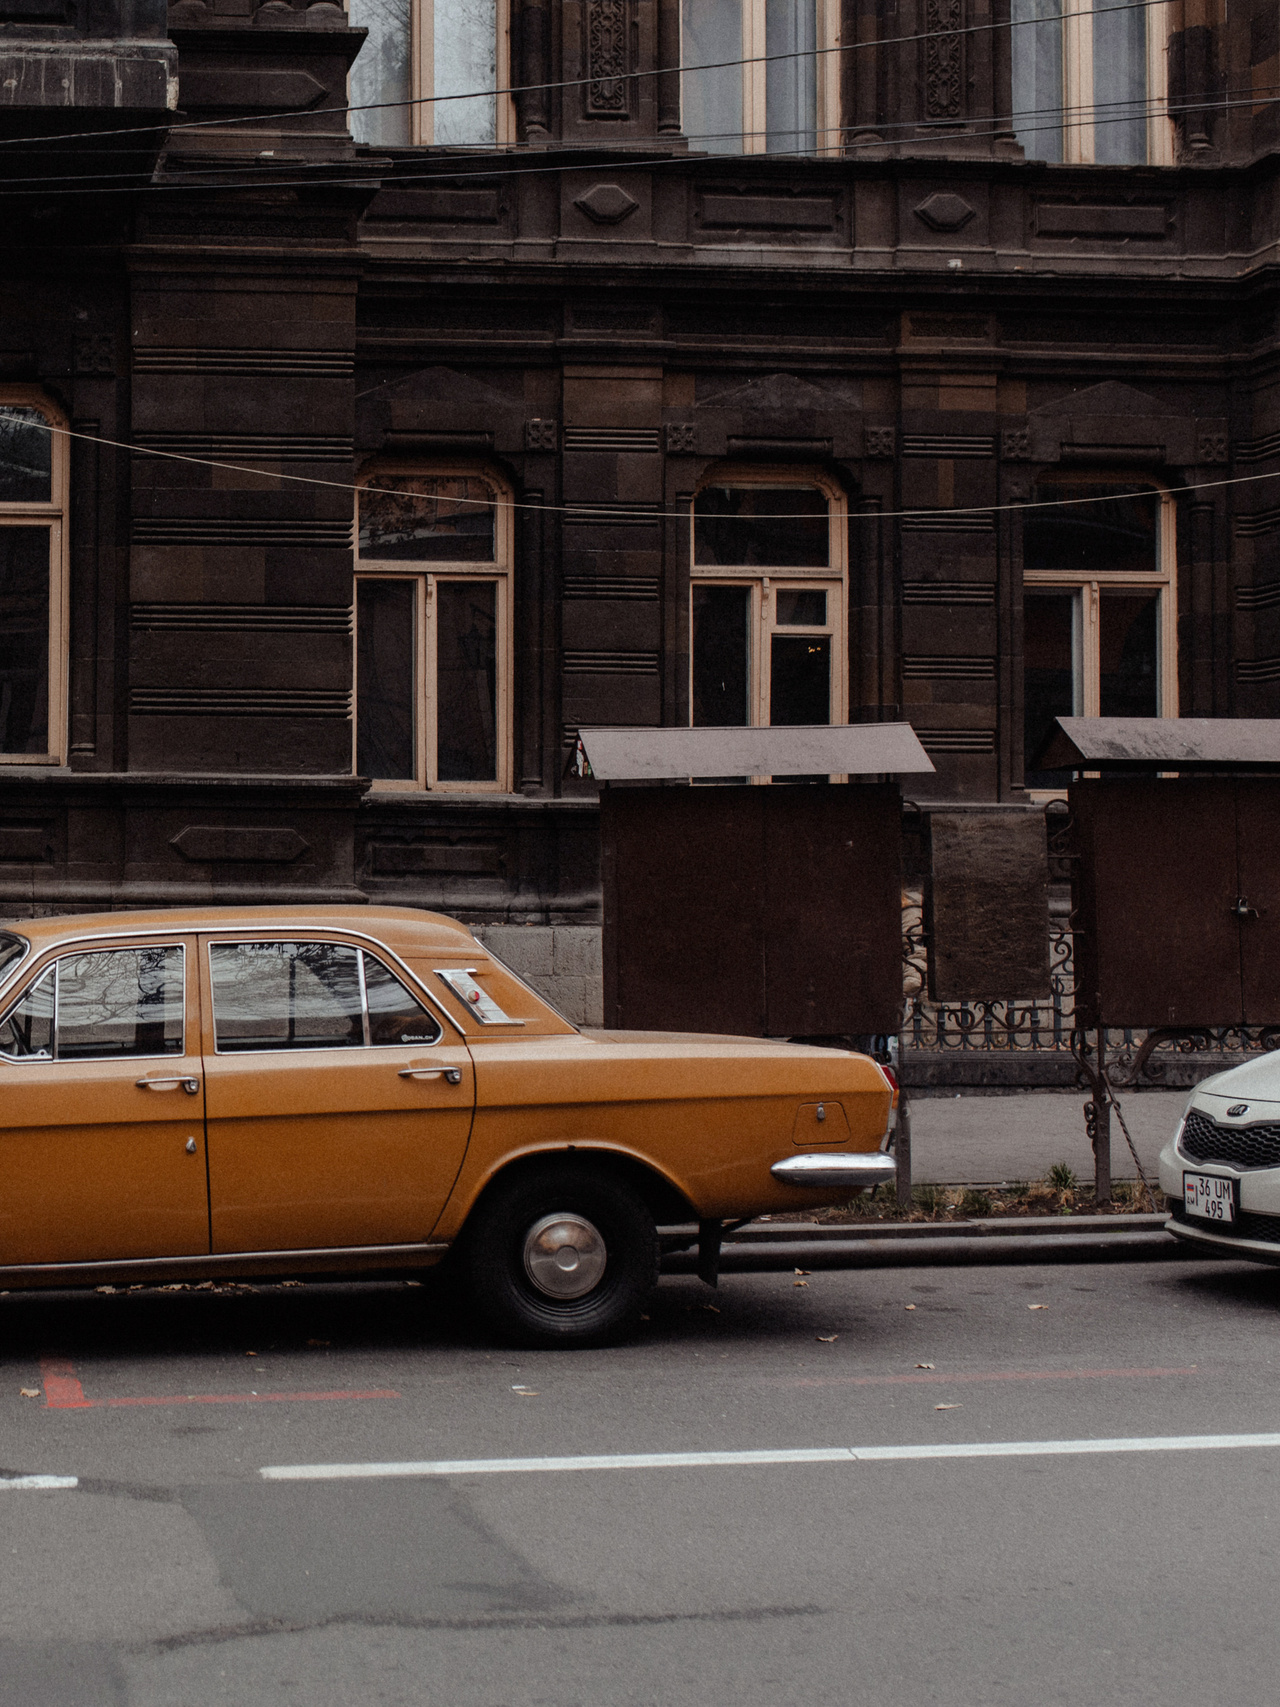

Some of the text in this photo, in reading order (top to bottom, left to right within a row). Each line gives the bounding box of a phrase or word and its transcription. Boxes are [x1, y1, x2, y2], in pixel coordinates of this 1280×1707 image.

[1198, 1178, 1231, 1200] 36 UM
[1205, 1200, 1224, 1219] 495
